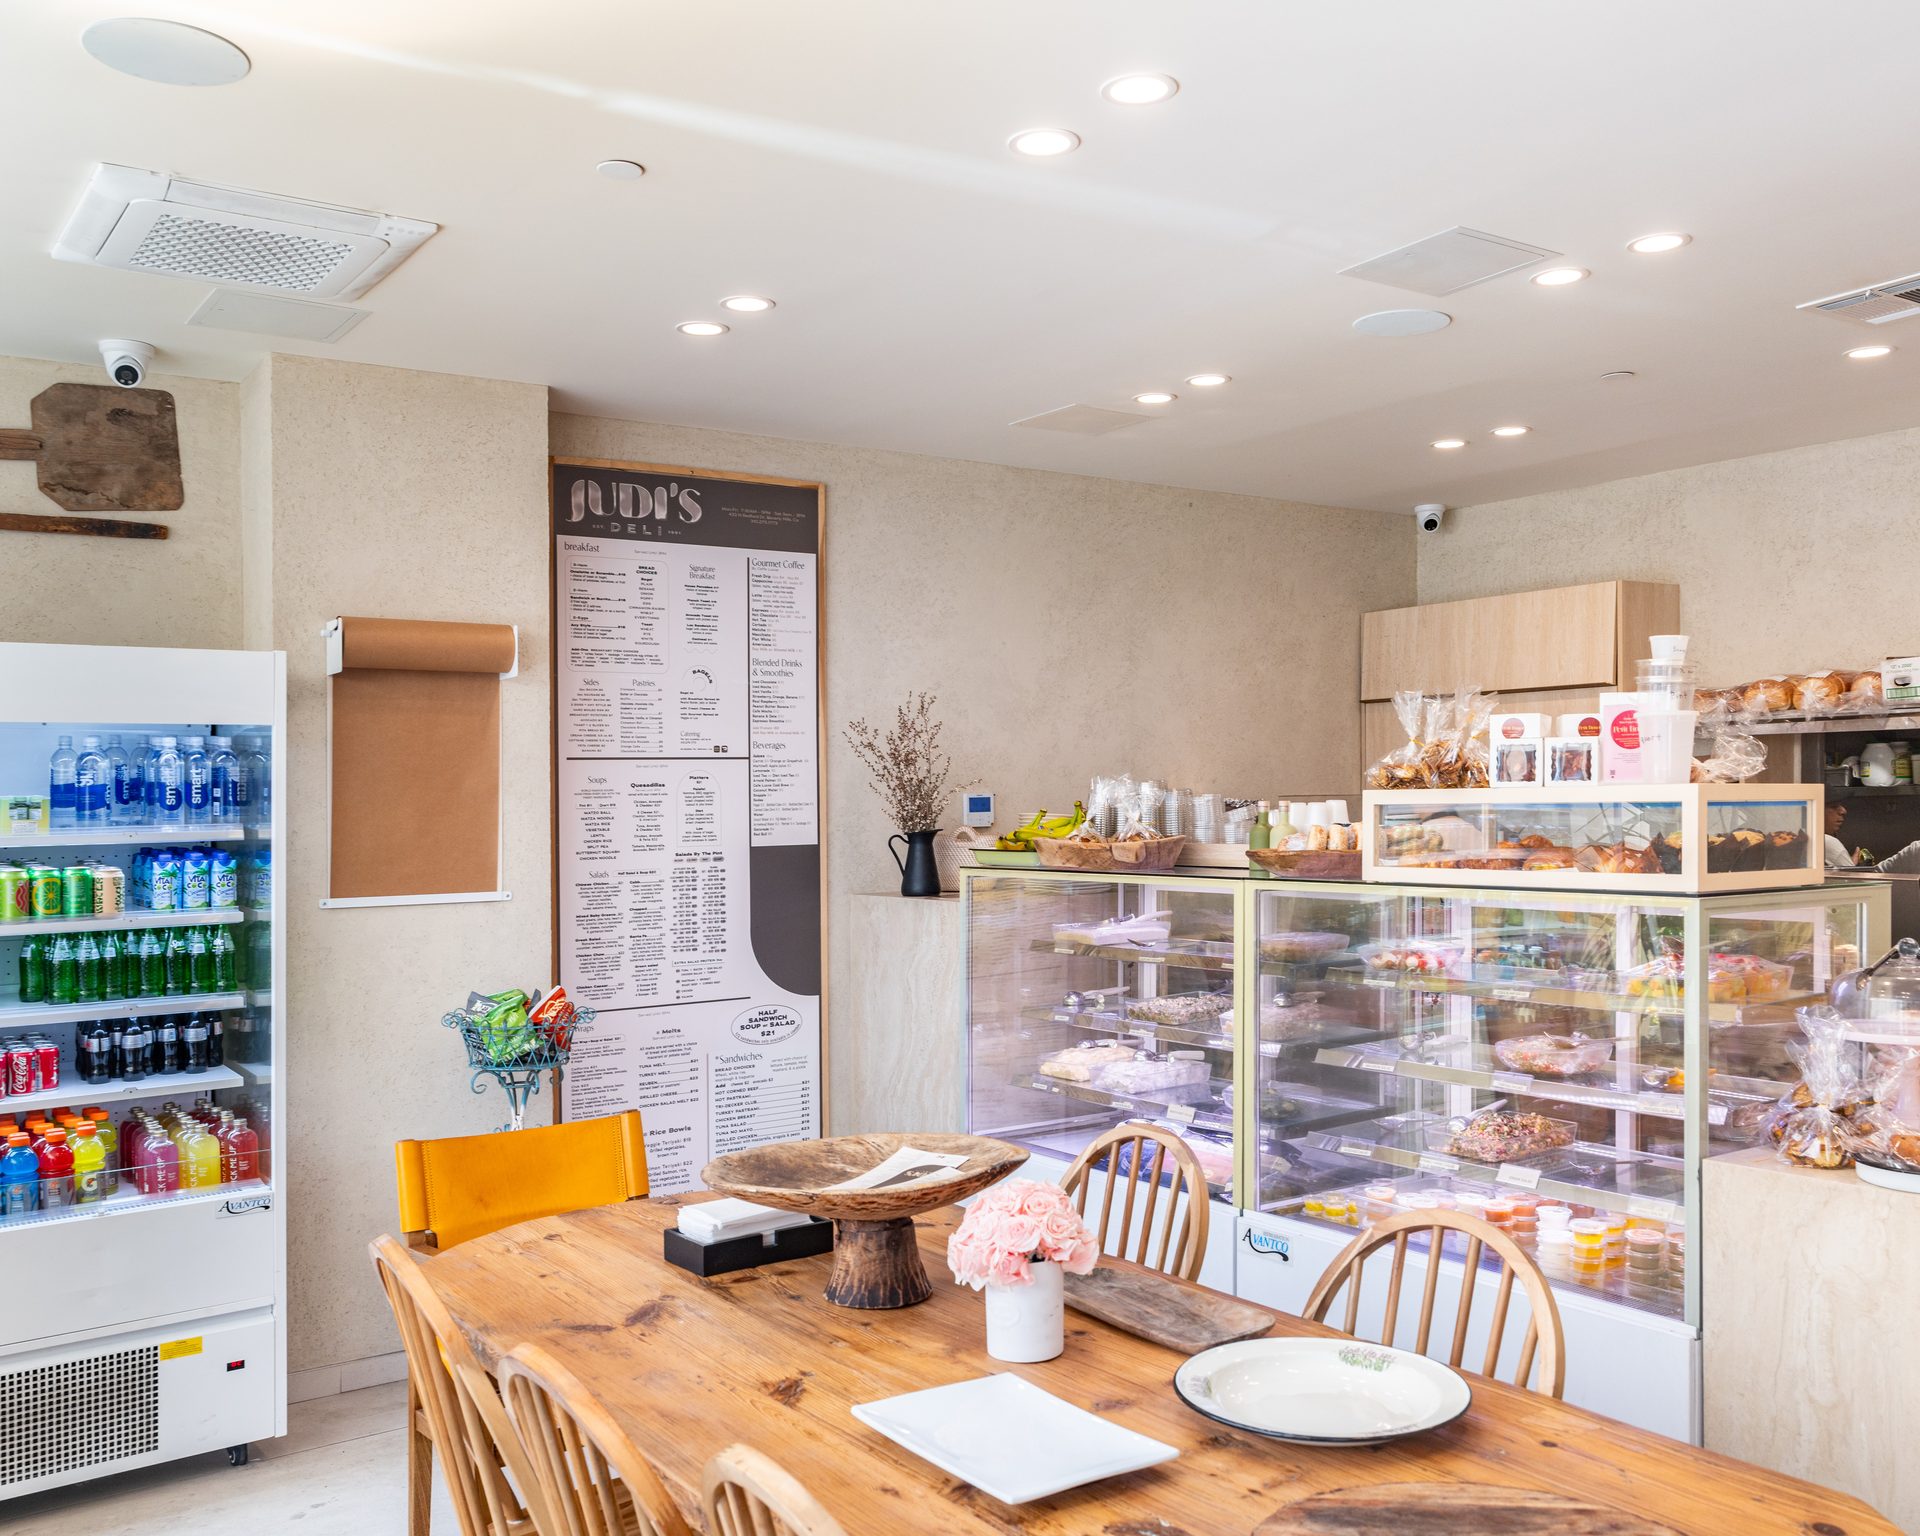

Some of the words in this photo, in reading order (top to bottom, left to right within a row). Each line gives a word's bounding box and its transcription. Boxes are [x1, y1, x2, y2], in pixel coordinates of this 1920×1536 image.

[566, 479, 702, 523] JUDI'S
[611, 523, 662, 536] DELI
[564, 542, 599, 552] breakfast
[689, 563, 716, 572] Signature
[752, 558, 781, 568] Gourmet
[783, 560, 805, 570] Coffee
[689, 571, 716, 580] Breakfast
[752, 658, 779, 667] Blended
[782, 658, 802, 667] Drinks
[692, 669, 712, 684] BAGELS
[752, 668, 758, 676] &
[760, 668, 794, 677] Smoothies
[583, 678, 600, 686] Sides
[632, 678, 656, 687] Pastries
[680, 730, 701, 738] Catering
[753, 741, 786, 751] Beverages
[191, 766, 202, 804] smart
[587, 776, 607, 785] Soups
[165, 767, 177, 806] smart
[188, 875, 206, 883] VITA
[217, 874, 234, 882] VITA
[589, 871, 609, 879] Salads
[155, 876, 170, 885] VITA
[748, 1014, 787, 1023] SANDWICH
[740, 1023, 761, 1031] SOUP
[769, 1019, 795, 1028] SALAD
[719, 1052, 763, 1065] Sandwiches
[715, 1101, 743, 1109] TRI-DECKER
[669, 1125, 691, 1133] Bowls
[228, 1144, 237, 1157] UP
[157, 1157, 165, 1168] UP
[229, 1157, 238, 1169] ME
[158, 1169, 167, 1182] ME
[190, 1165, 197, 1176] ME
[229, 1171, 238, 1183] ICK
[158, 1183, 167, 1193] CK
[218, 1198, 271, 1212] AVANTCO
[1242, 1228, 1289, 1256] AVANTCO
